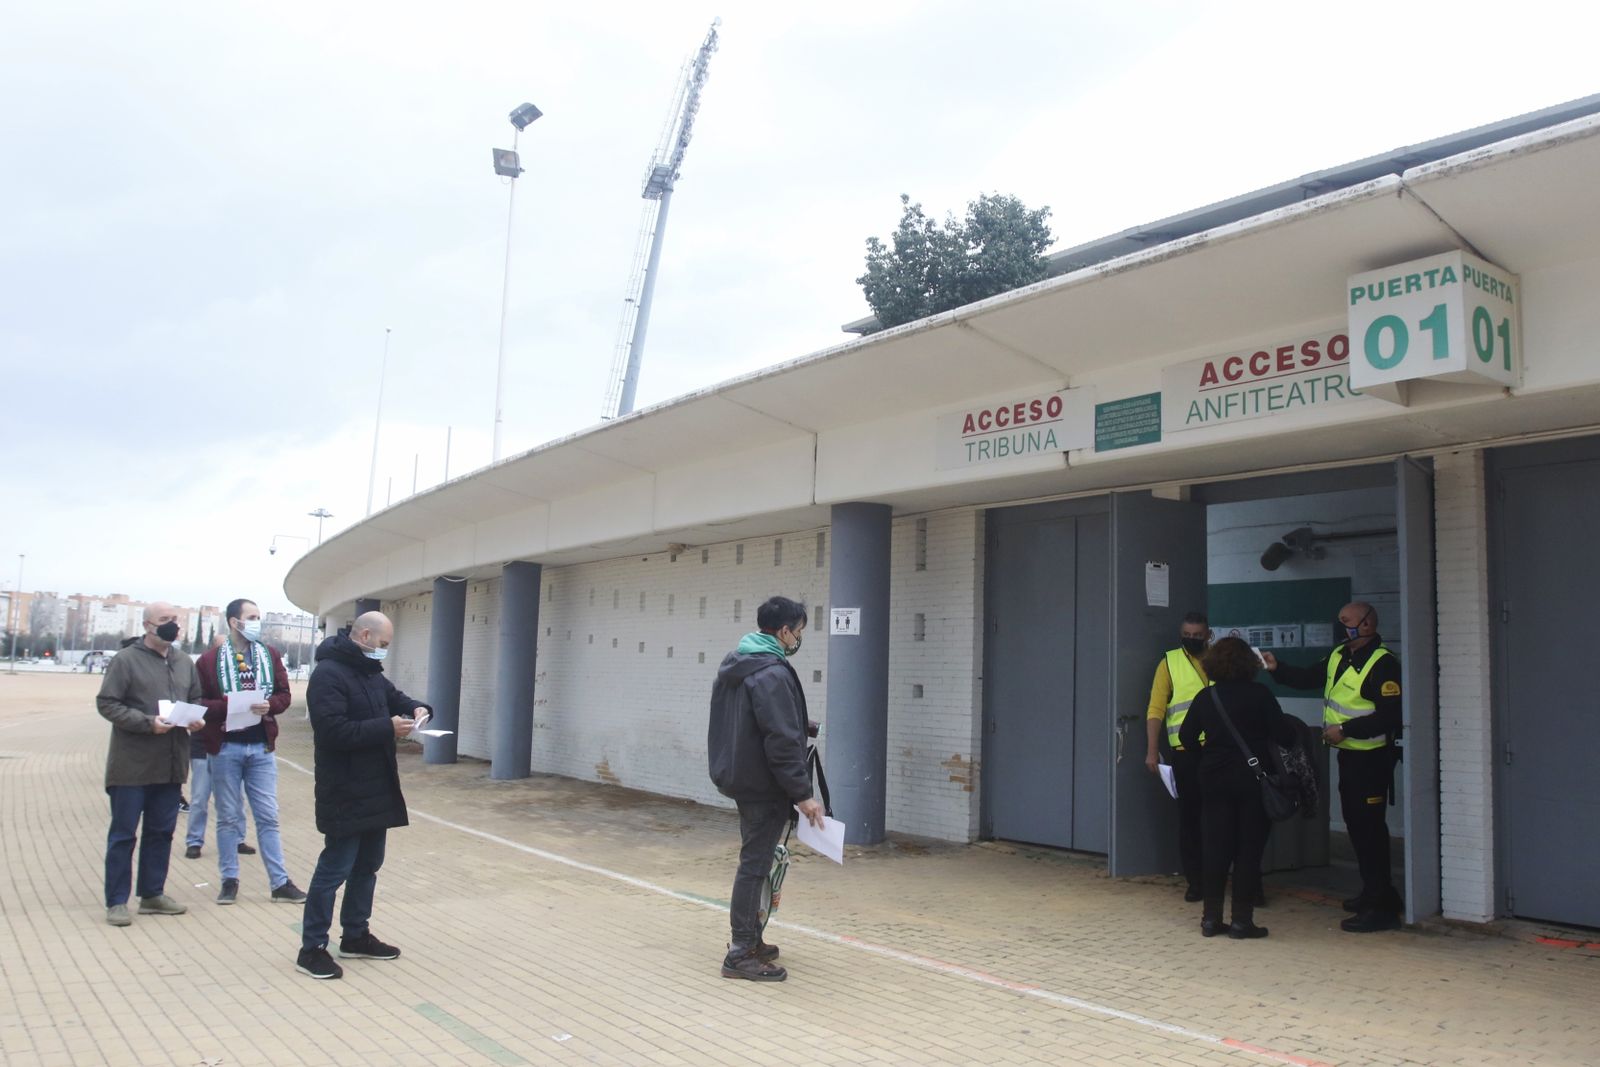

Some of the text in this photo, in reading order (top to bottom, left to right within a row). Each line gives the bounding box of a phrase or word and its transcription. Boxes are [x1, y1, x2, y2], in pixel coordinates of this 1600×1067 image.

[1351, 265, 1458, 306] PUERTA
[1462, 263, 1514, 305] PUERTA
[1364, 303, 1450, 370] 01
[1472, 305, 1512, 372] 01
[1199, 334, 1349, 387] ACCESO
[962, 395, 1063, 434] ACCESO
[964, 428, 1058, 462] TRIBUNA
